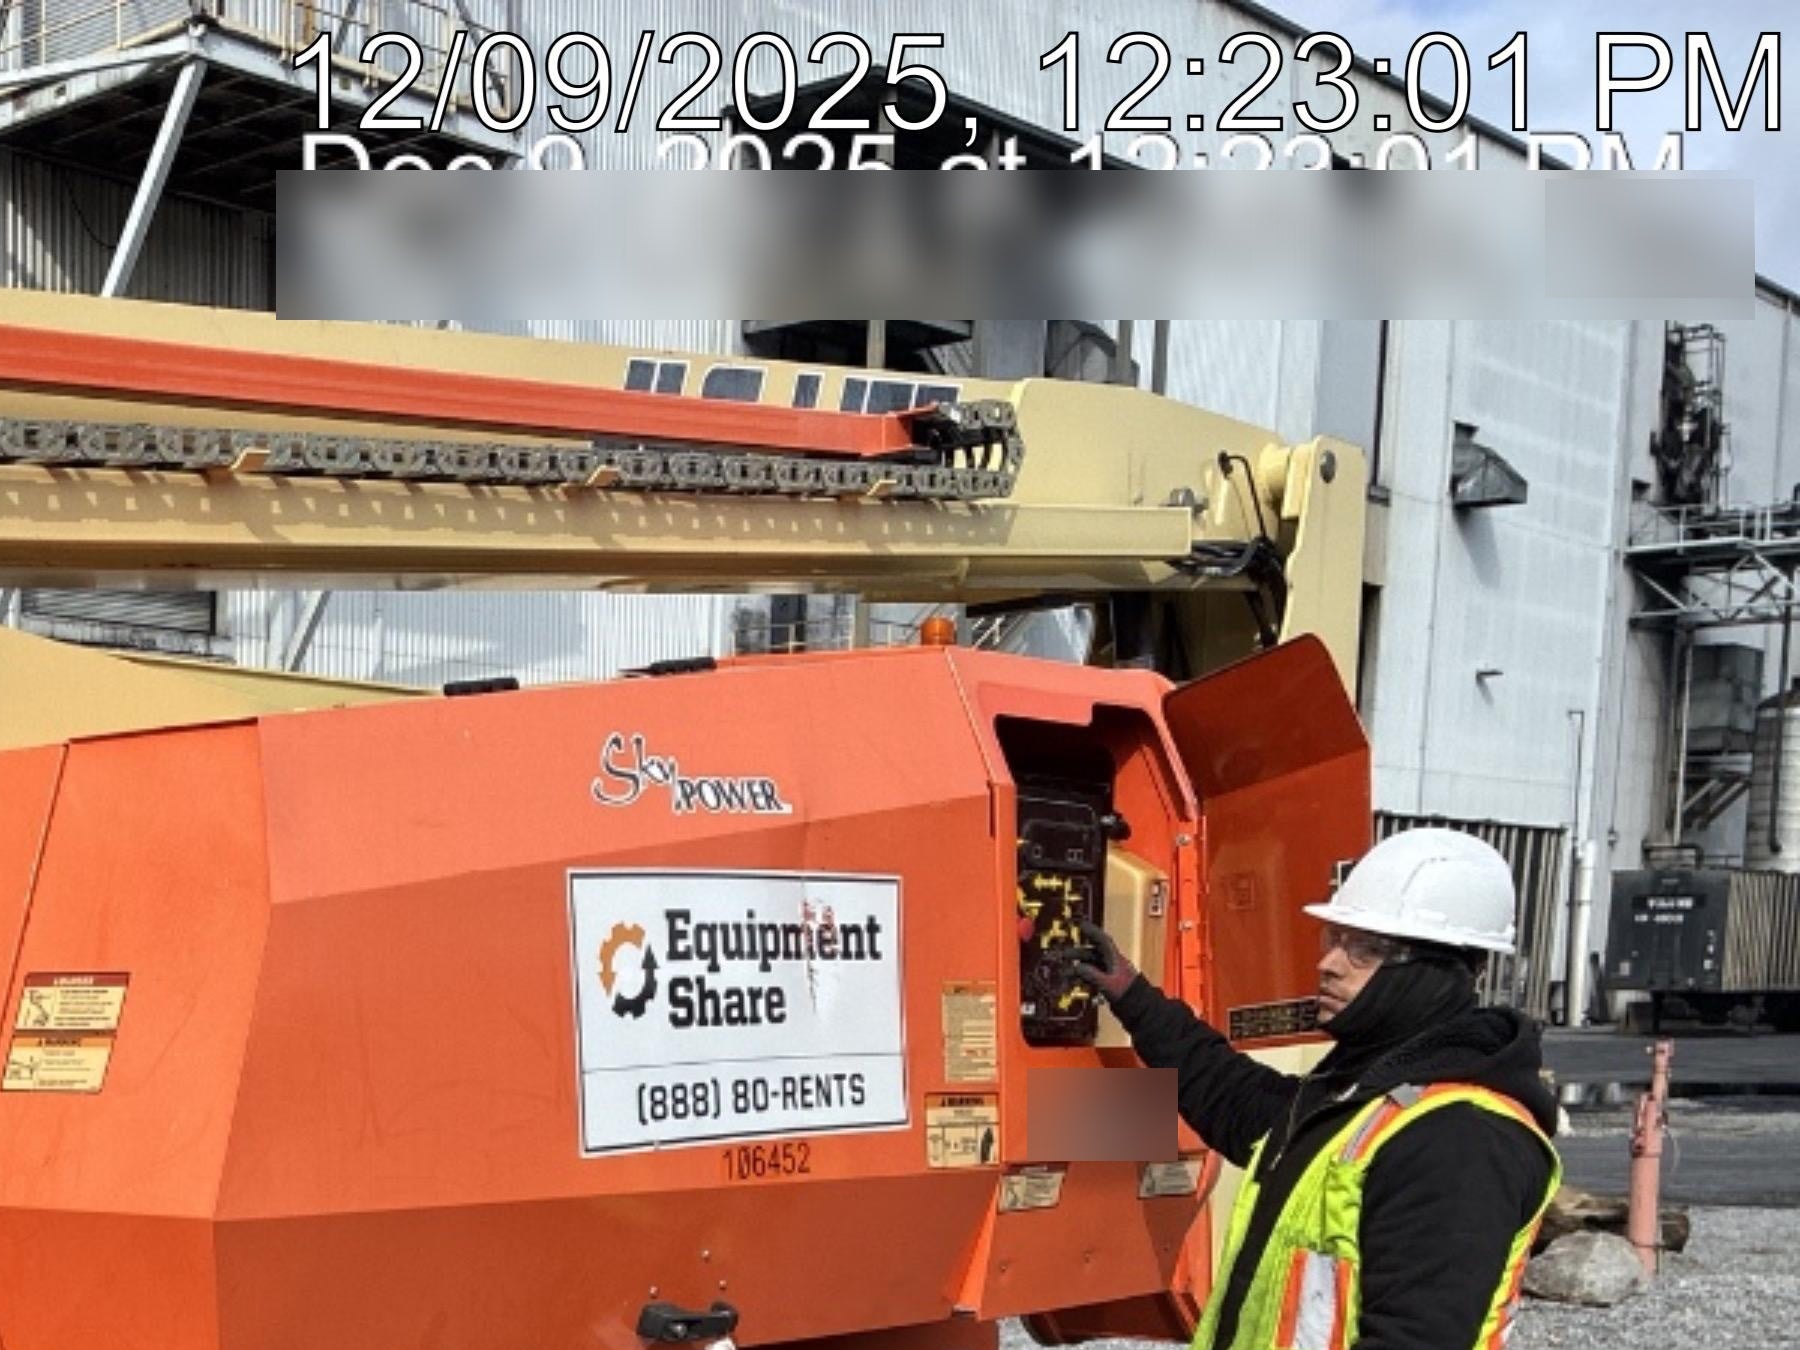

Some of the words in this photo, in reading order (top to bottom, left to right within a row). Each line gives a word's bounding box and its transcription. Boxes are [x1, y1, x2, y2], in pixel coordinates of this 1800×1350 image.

[675, 776, 786, 814] POWER
[664, 909, 882, 972] Equipment
[668, 975, 787, 1028] Share
[637, 1079, 722, 1126] (888)
[732, 1072, 867, 1114] 80-RENTS
